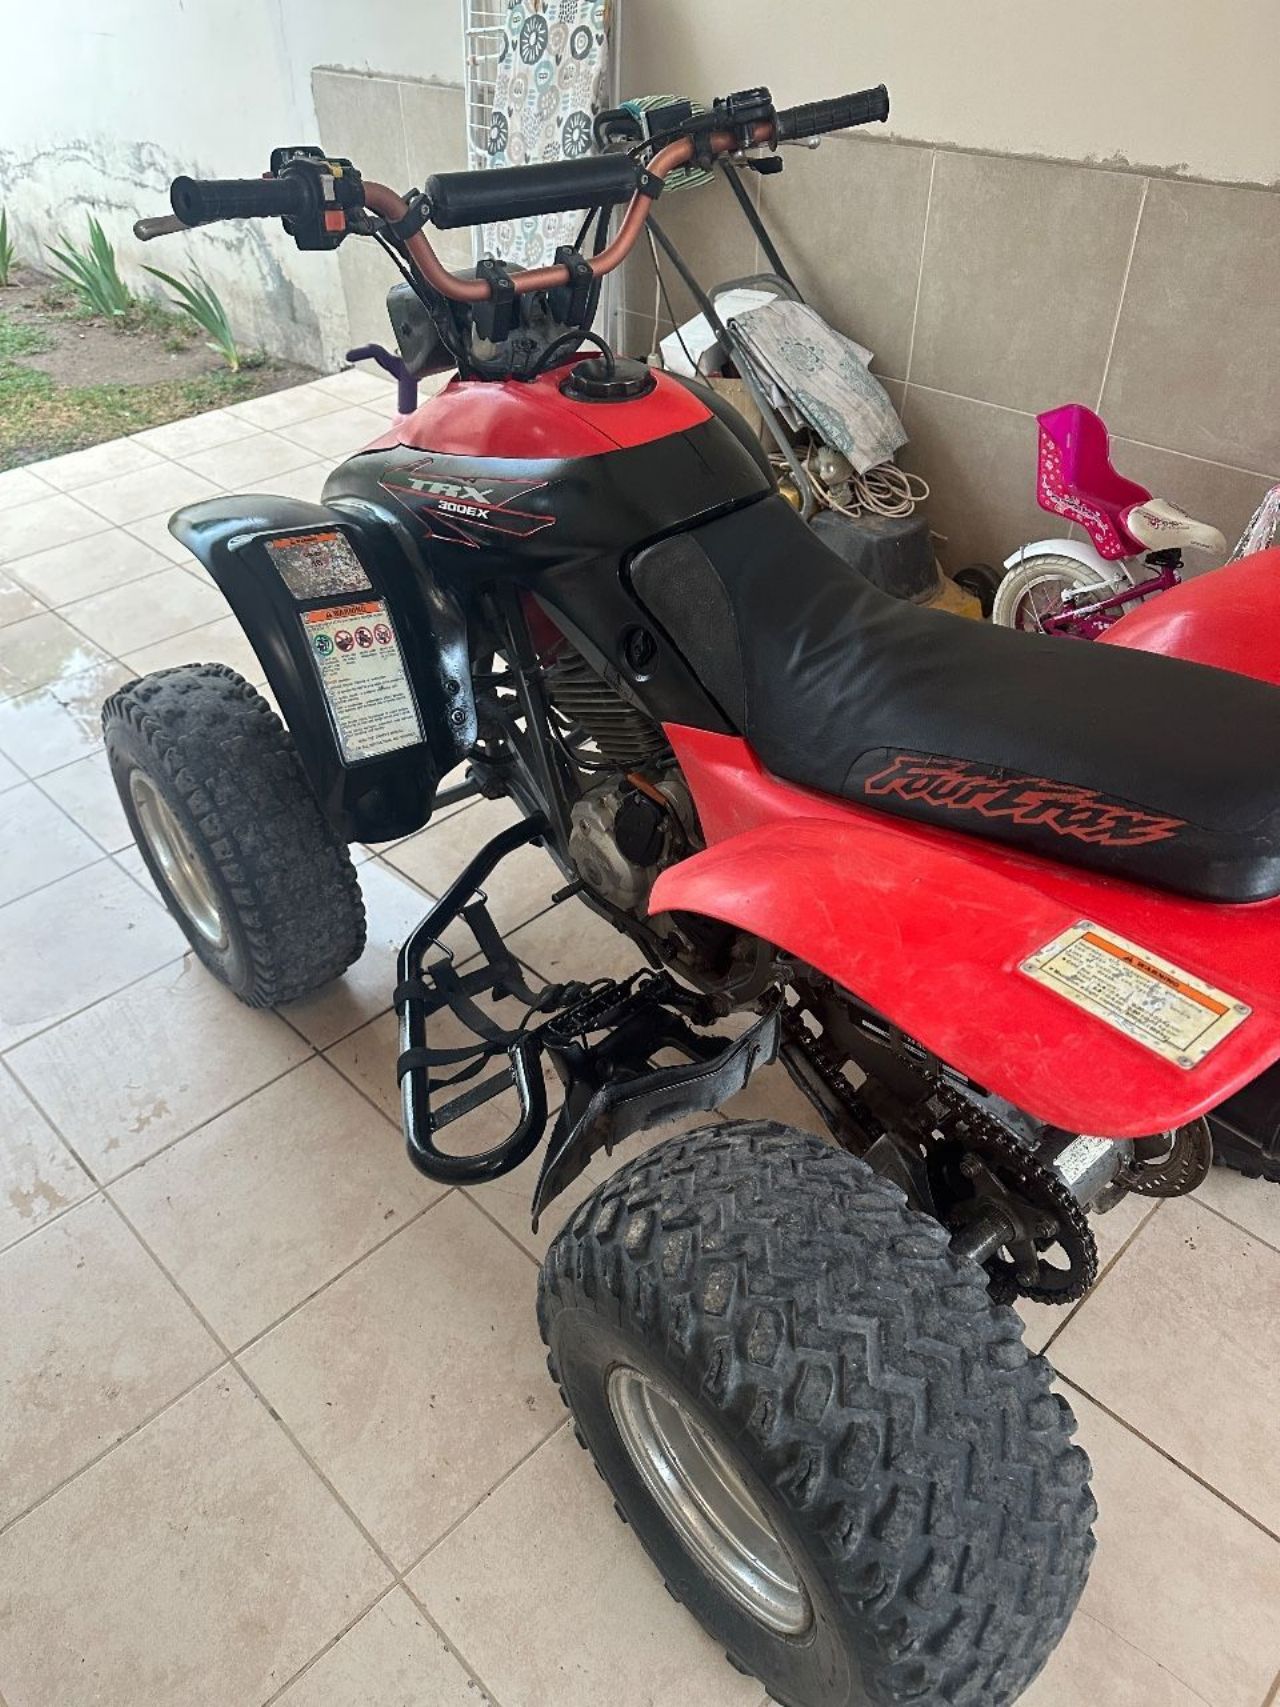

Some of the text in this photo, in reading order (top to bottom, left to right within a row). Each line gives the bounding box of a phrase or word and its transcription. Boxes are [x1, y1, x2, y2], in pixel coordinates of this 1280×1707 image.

[408, 478, 494, 504] TRX
[438, 500, 490, 519] 300EX
[1136, 961, 1181, 988] WARNING
